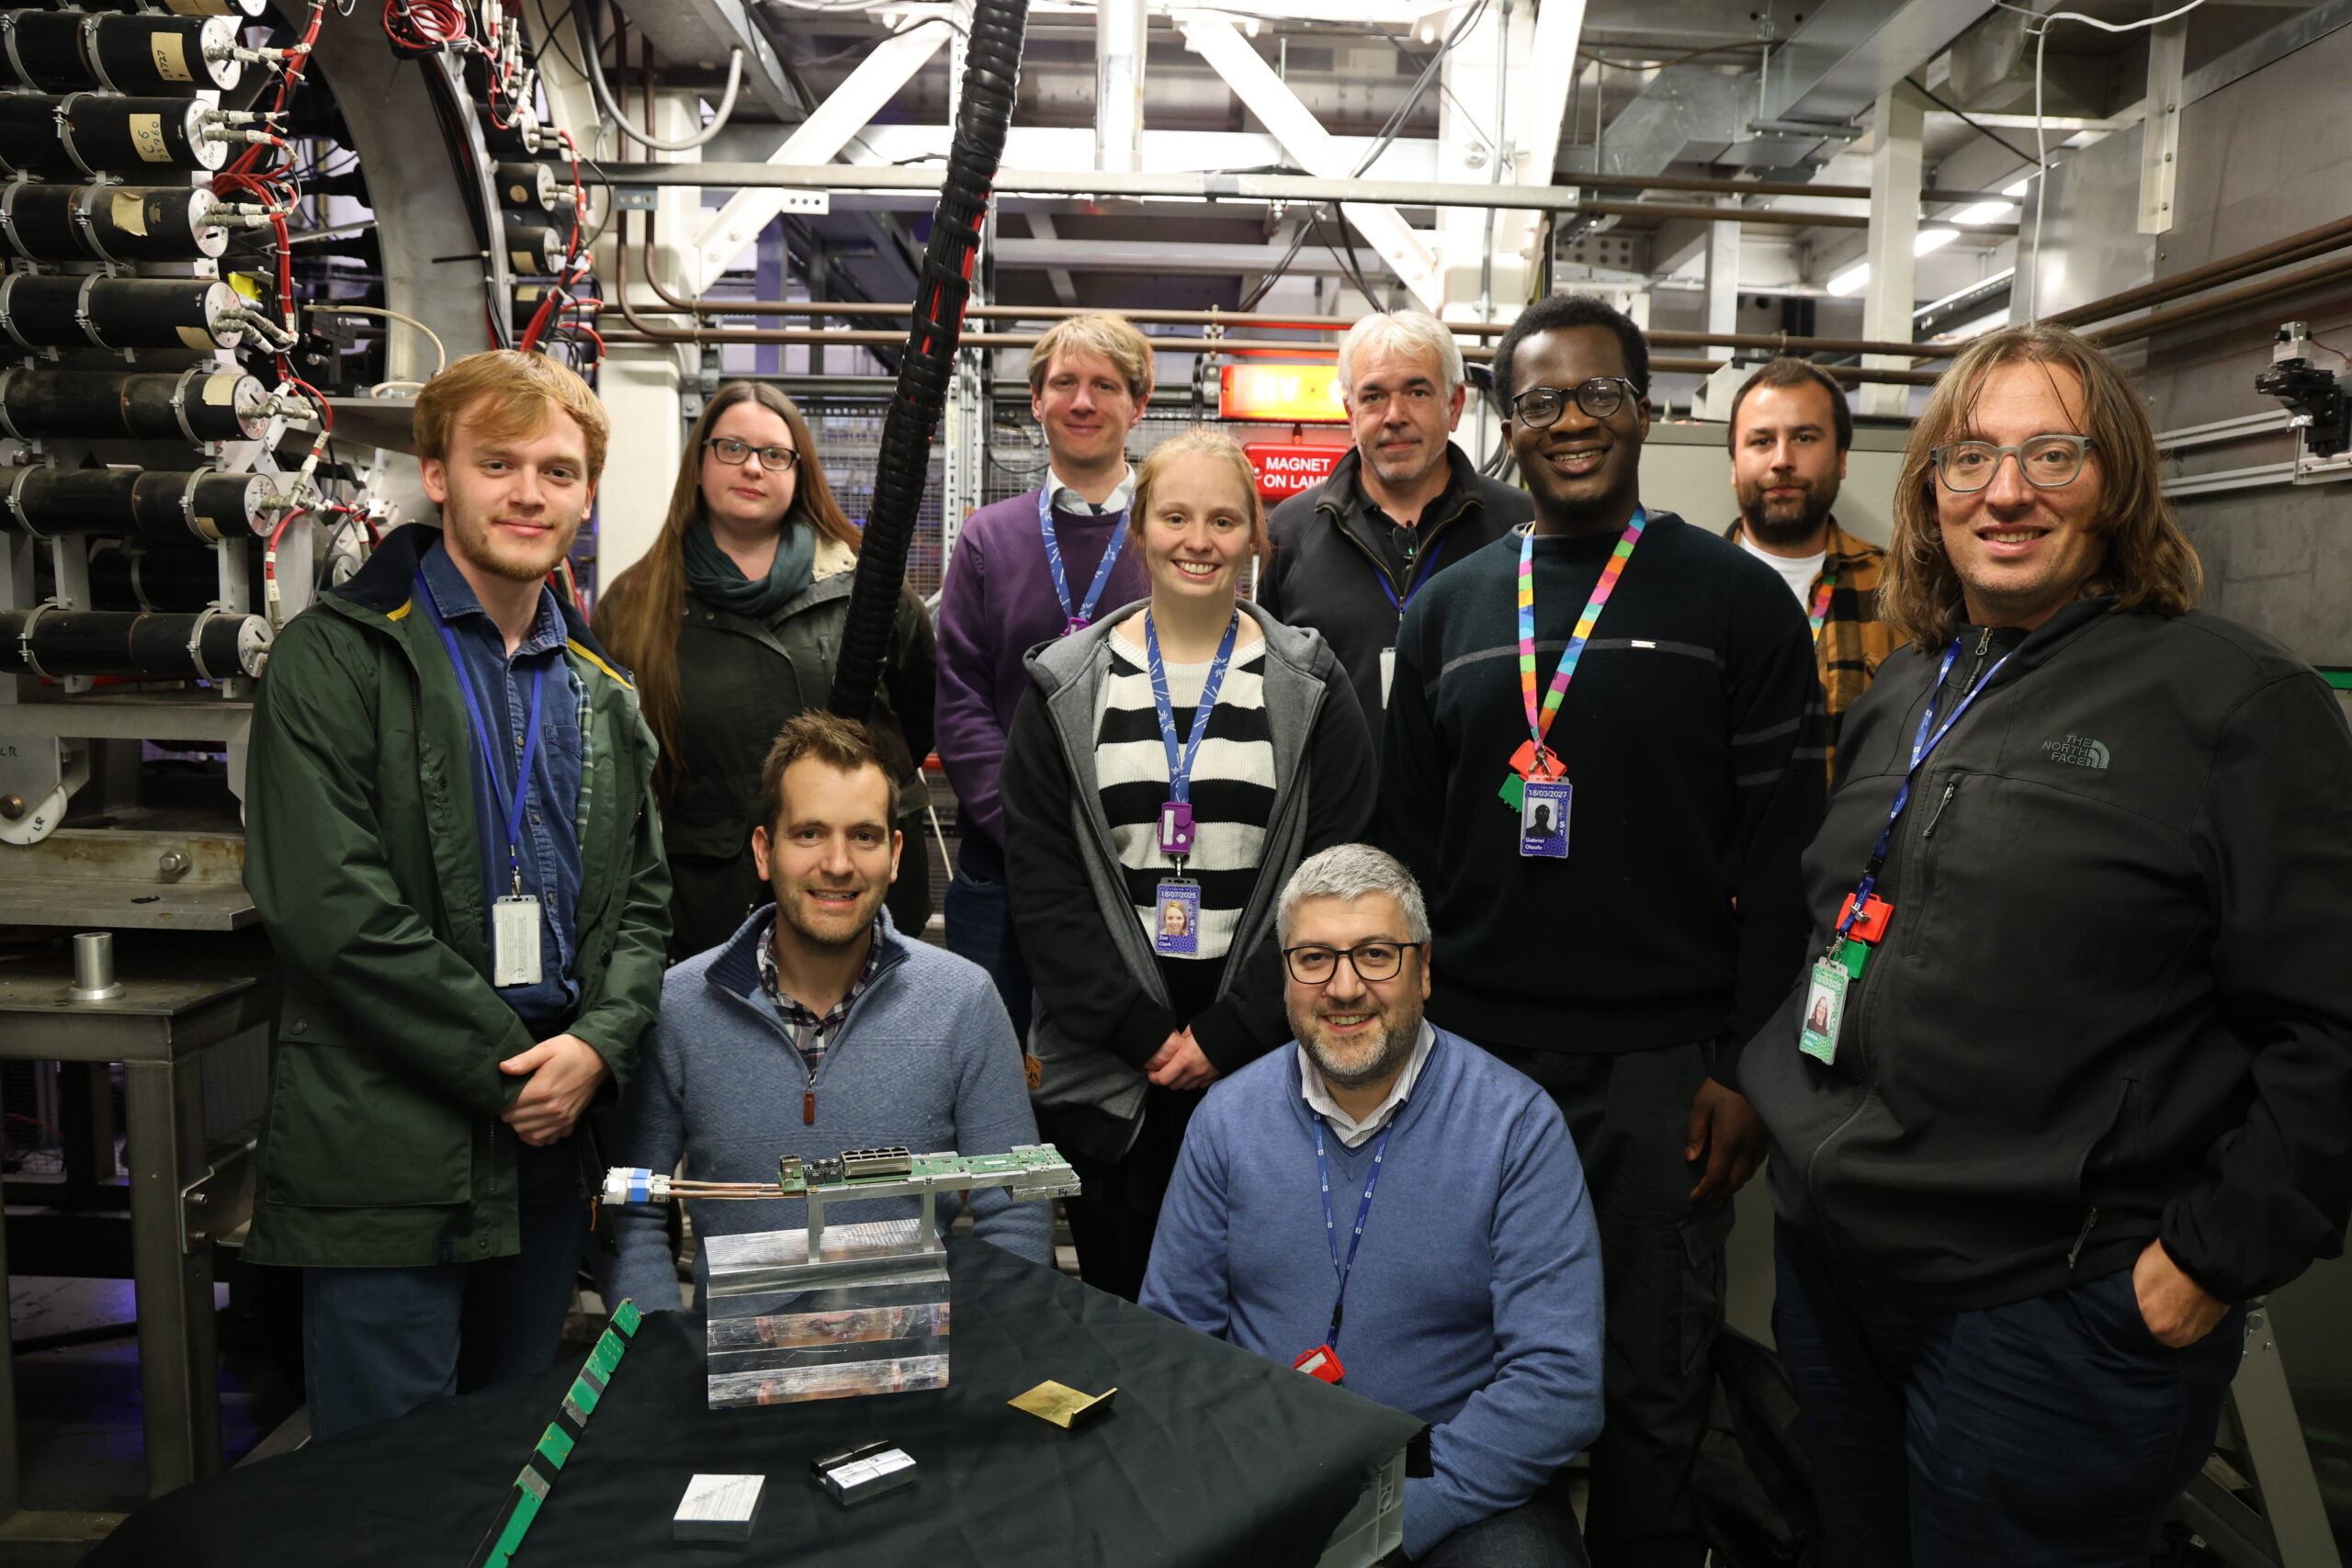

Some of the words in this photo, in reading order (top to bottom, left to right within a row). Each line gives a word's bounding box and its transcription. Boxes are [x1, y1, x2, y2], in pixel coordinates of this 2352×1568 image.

[1266, 457, 1330, 472] MAGNET
[1263, 474, 1286, 488] ON
[2041, 740, 2088, 757] NORTH
[2066, 735, 2092, 748] THE
[2052, 751, 2086, 766] FACE
[1528, 790, 1567, 798] 18/03/2027
